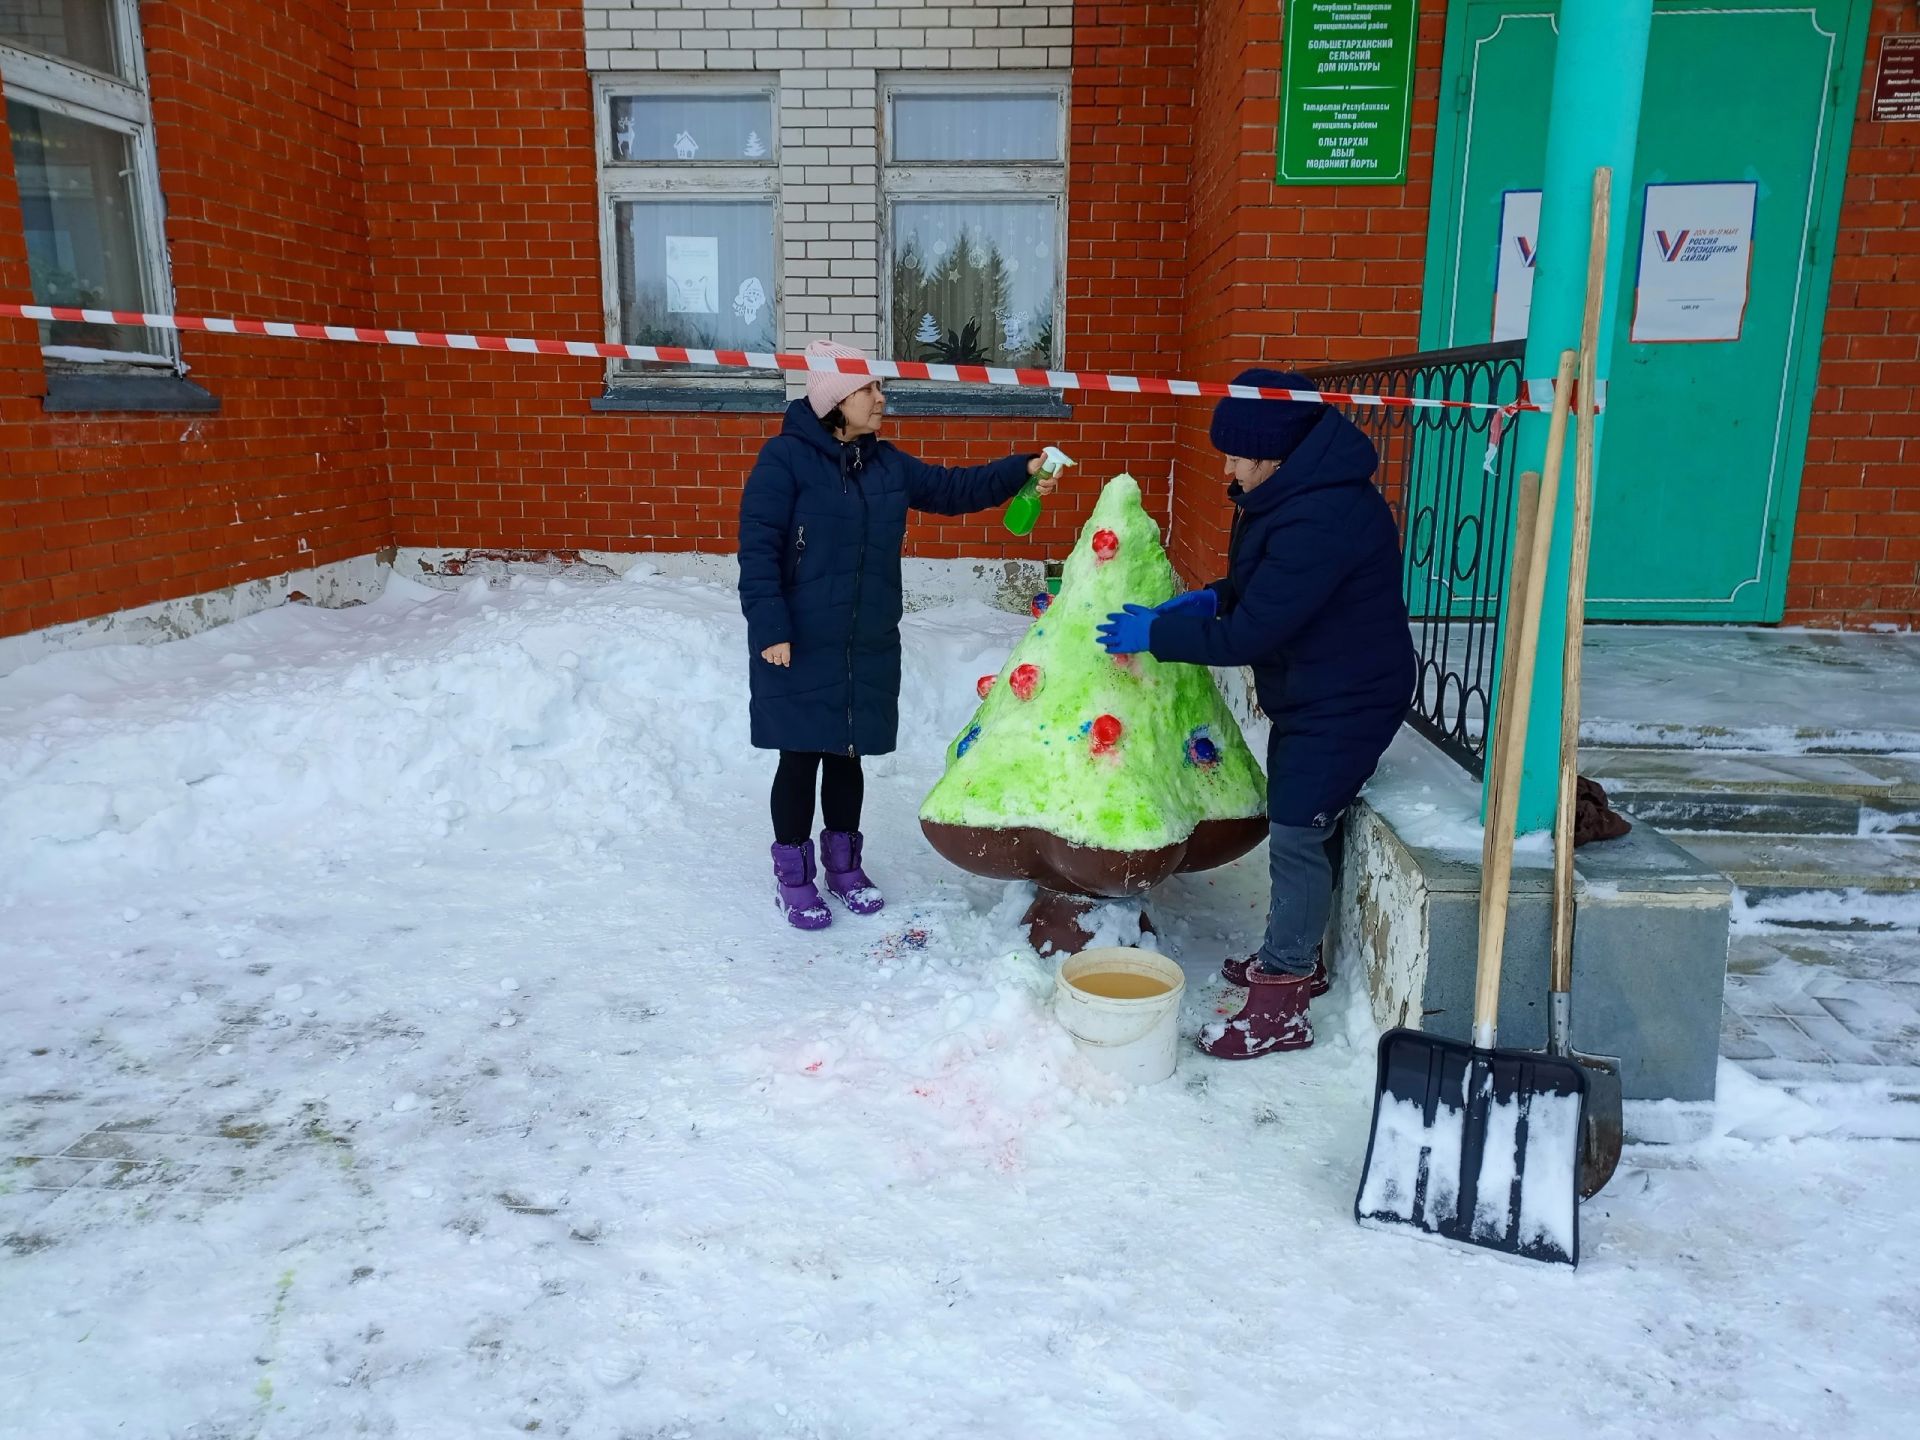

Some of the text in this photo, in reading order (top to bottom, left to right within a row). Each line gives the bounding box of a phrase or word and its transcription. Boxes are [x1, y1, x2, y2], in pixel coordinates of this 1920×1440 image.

[1312, 3, 1392, 12] Республика Татарстан
[1332, 12, 1371, 21] Тетюшский
[1314, 22, 1388, 32] муниципальный район
[1308, 38, 1393, 49] БОЛЬШЕТАРХАНСКИЙ
[1329, 50, 1371, 60] СЕЛЬСКИЙ
[1317, 62, 1380, 74] ДОМ КУЛЬТУРЫ
[1303, 103, 1390, 112] Татарстан Республикасы
[1312, 122, 1352, 131] муниципаль
[1318, 137, 1368, 146] ОЛЫ ТАРХАН
[1331, 148, 1354, 157] АВЫЛ
[1351, 158, 1378, 168] ЙОРТЫ
[1684, 245, 1738, 253] ПРЕЗИДЕНТЫН
[1680, 254, 1711, 262] САЙЛАУ
